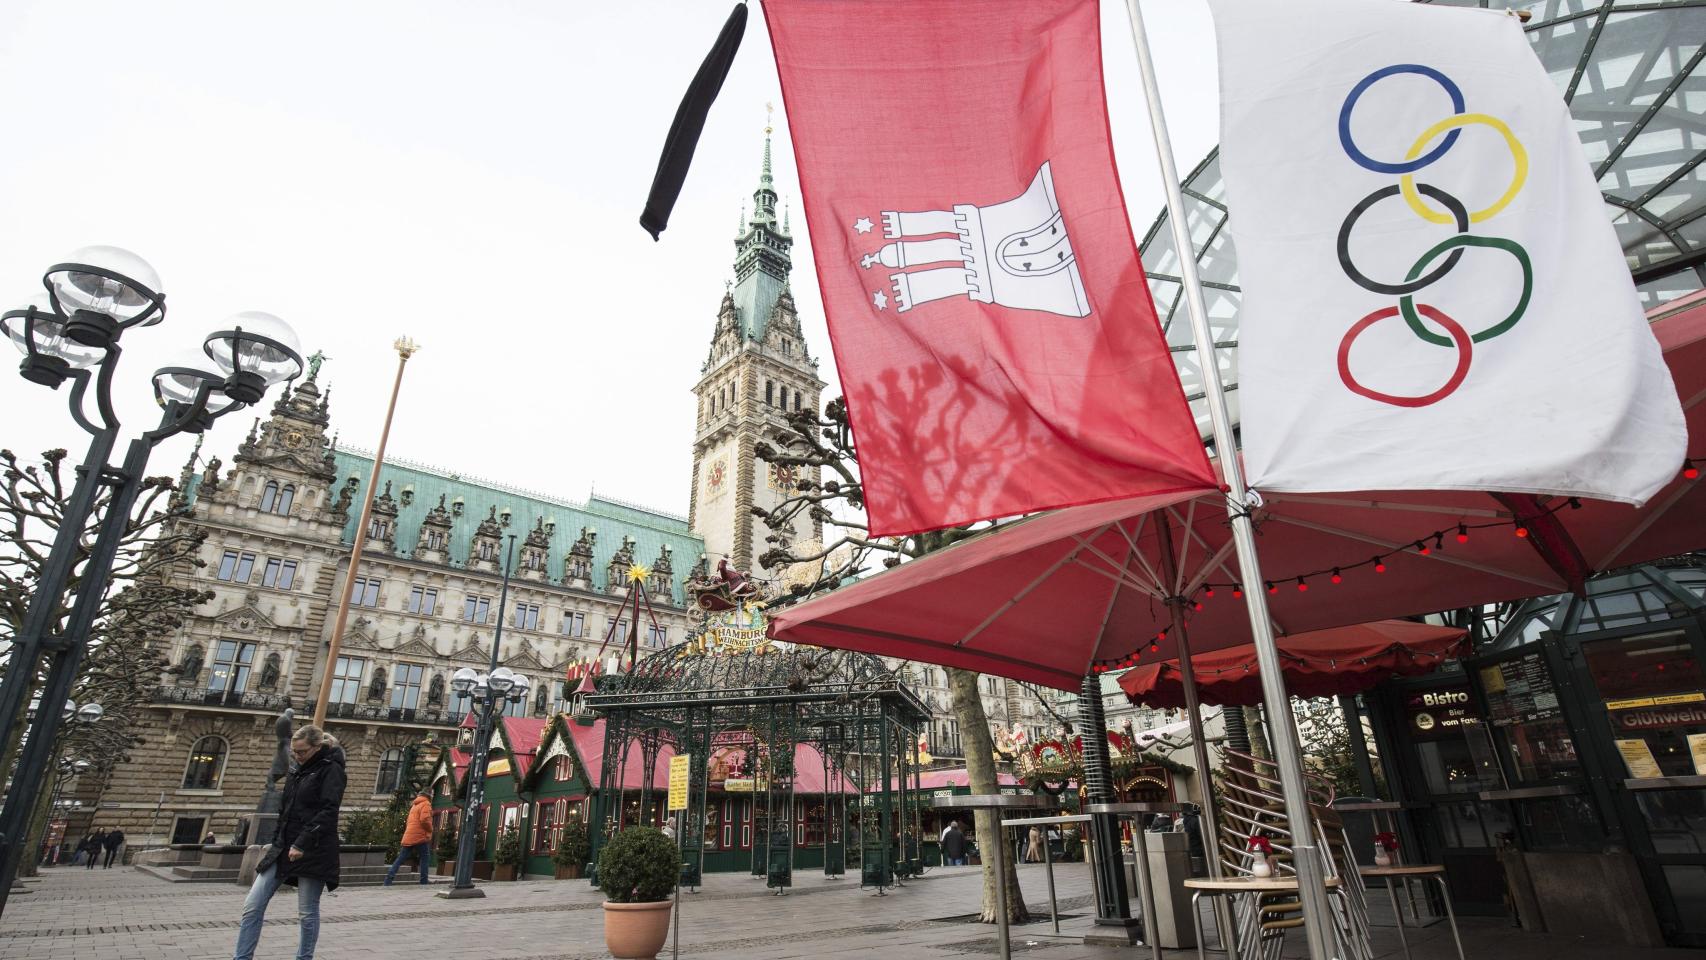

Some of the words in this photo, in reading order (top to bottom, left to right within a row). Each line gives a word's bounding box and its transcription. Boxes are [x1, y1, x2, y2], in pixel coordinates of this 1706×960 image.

[1423, 691, 1469, 706] Bistro
[1448, 708, 1465, 716] Bier
[1623, 707, 1706, 727] Glühwein
[1441, 719, 1459, 727] vom
